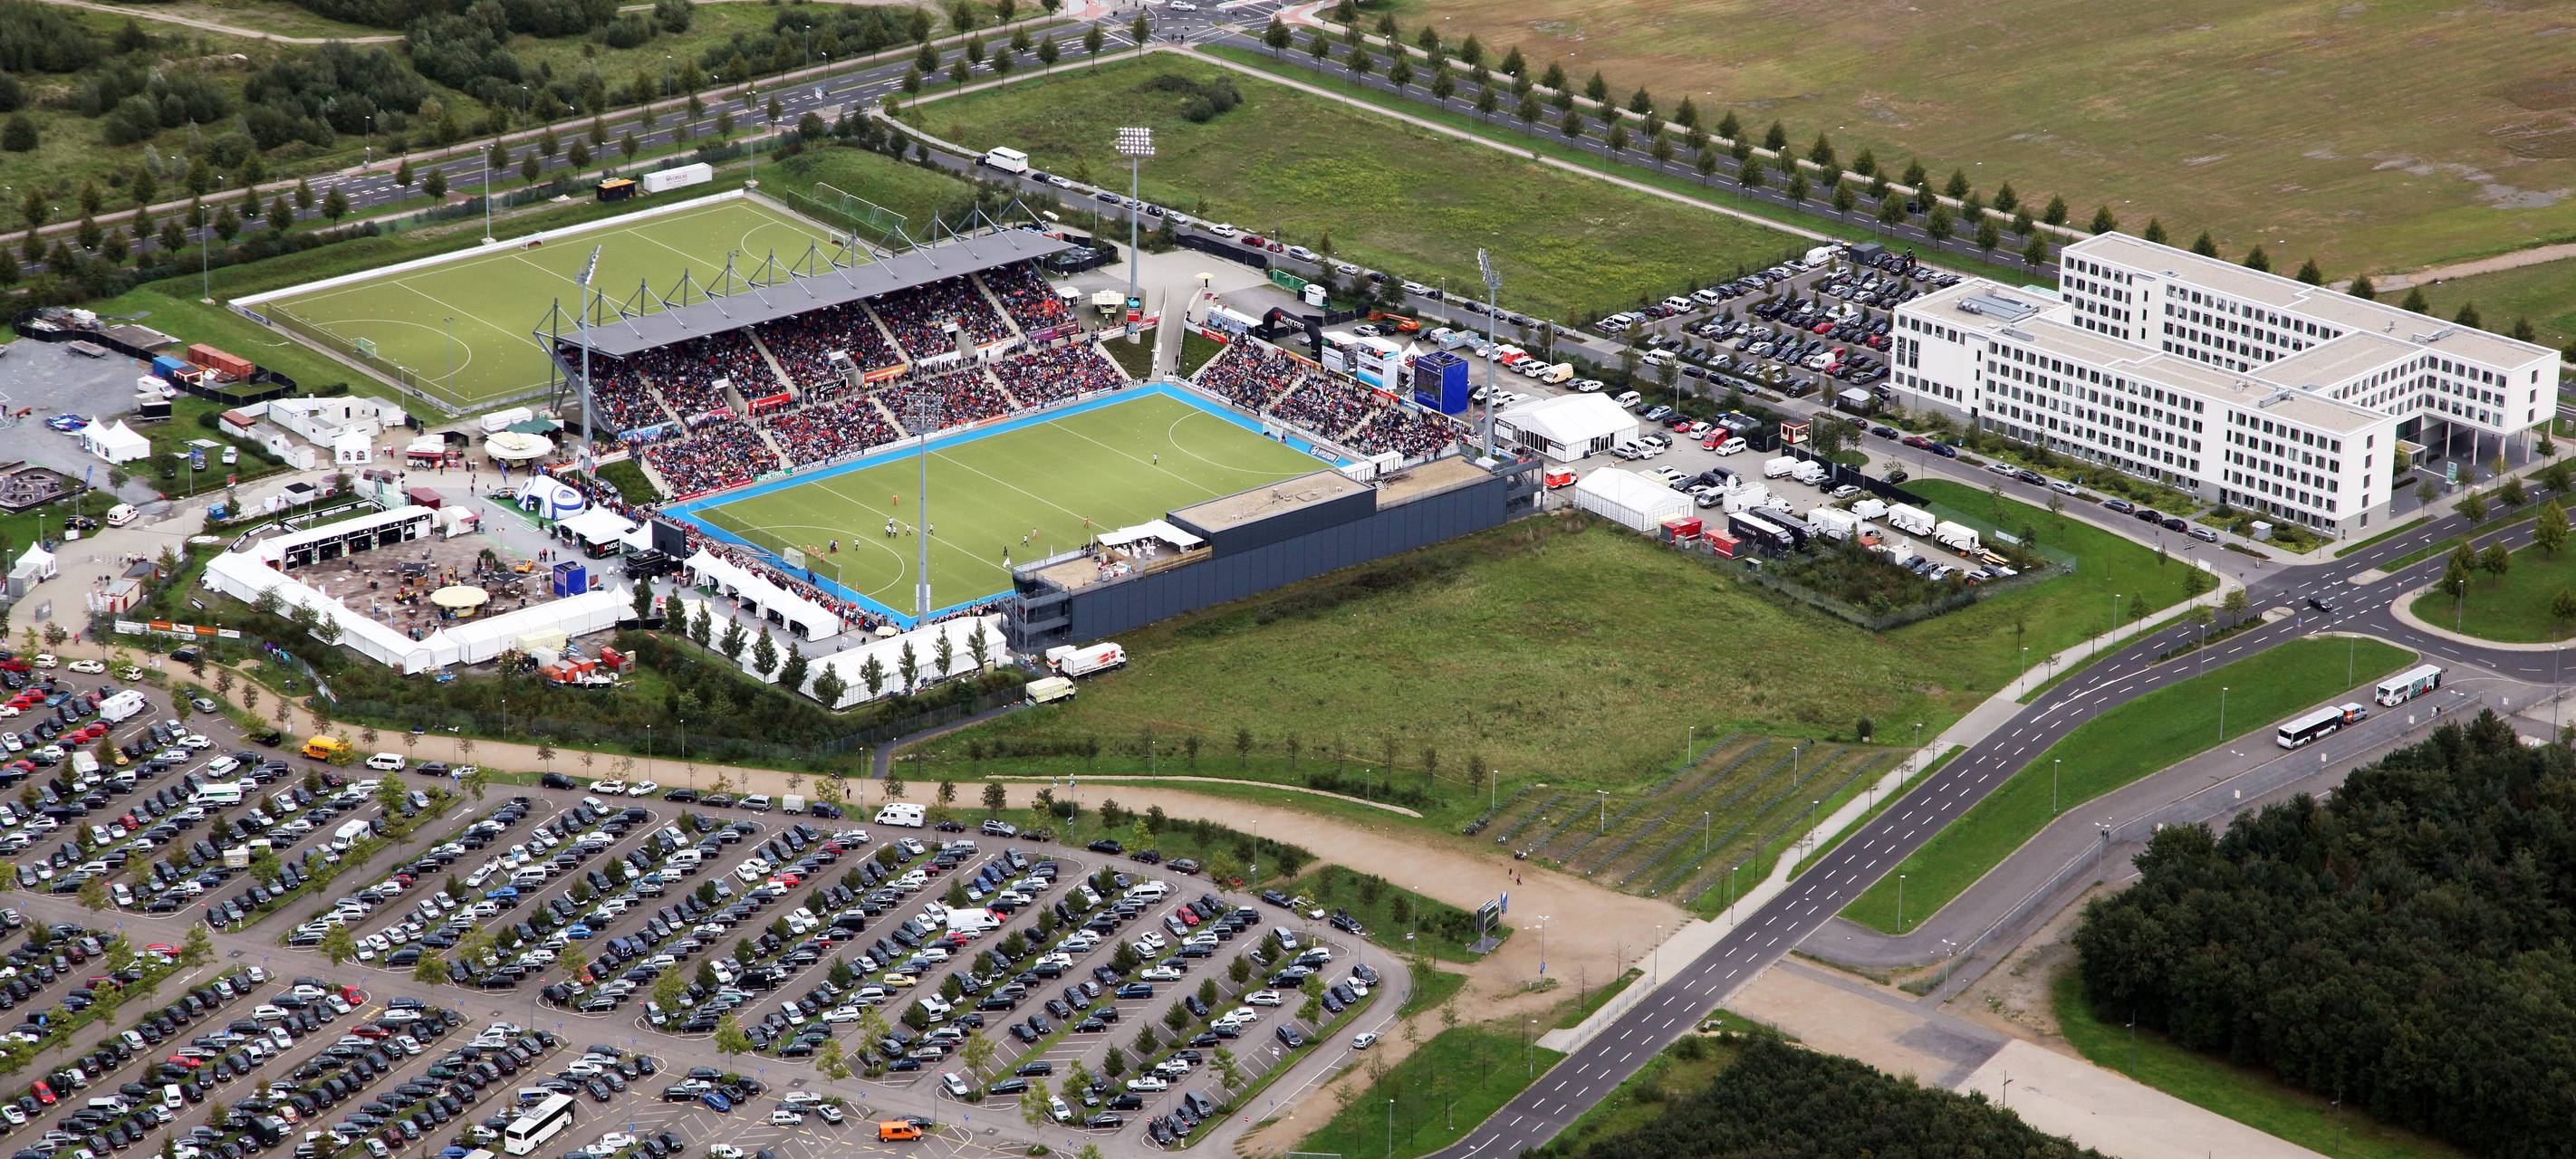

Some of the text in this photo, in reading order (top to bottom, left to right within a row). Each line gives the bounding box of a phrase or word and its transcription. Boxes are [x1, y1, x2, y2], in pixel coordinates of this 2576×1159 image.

[835, 451, 862, 463] HYUNDAI
[798, 460, 825, 472] HYUNDAI
[1737, 523, 1757, 536] livecast.de
